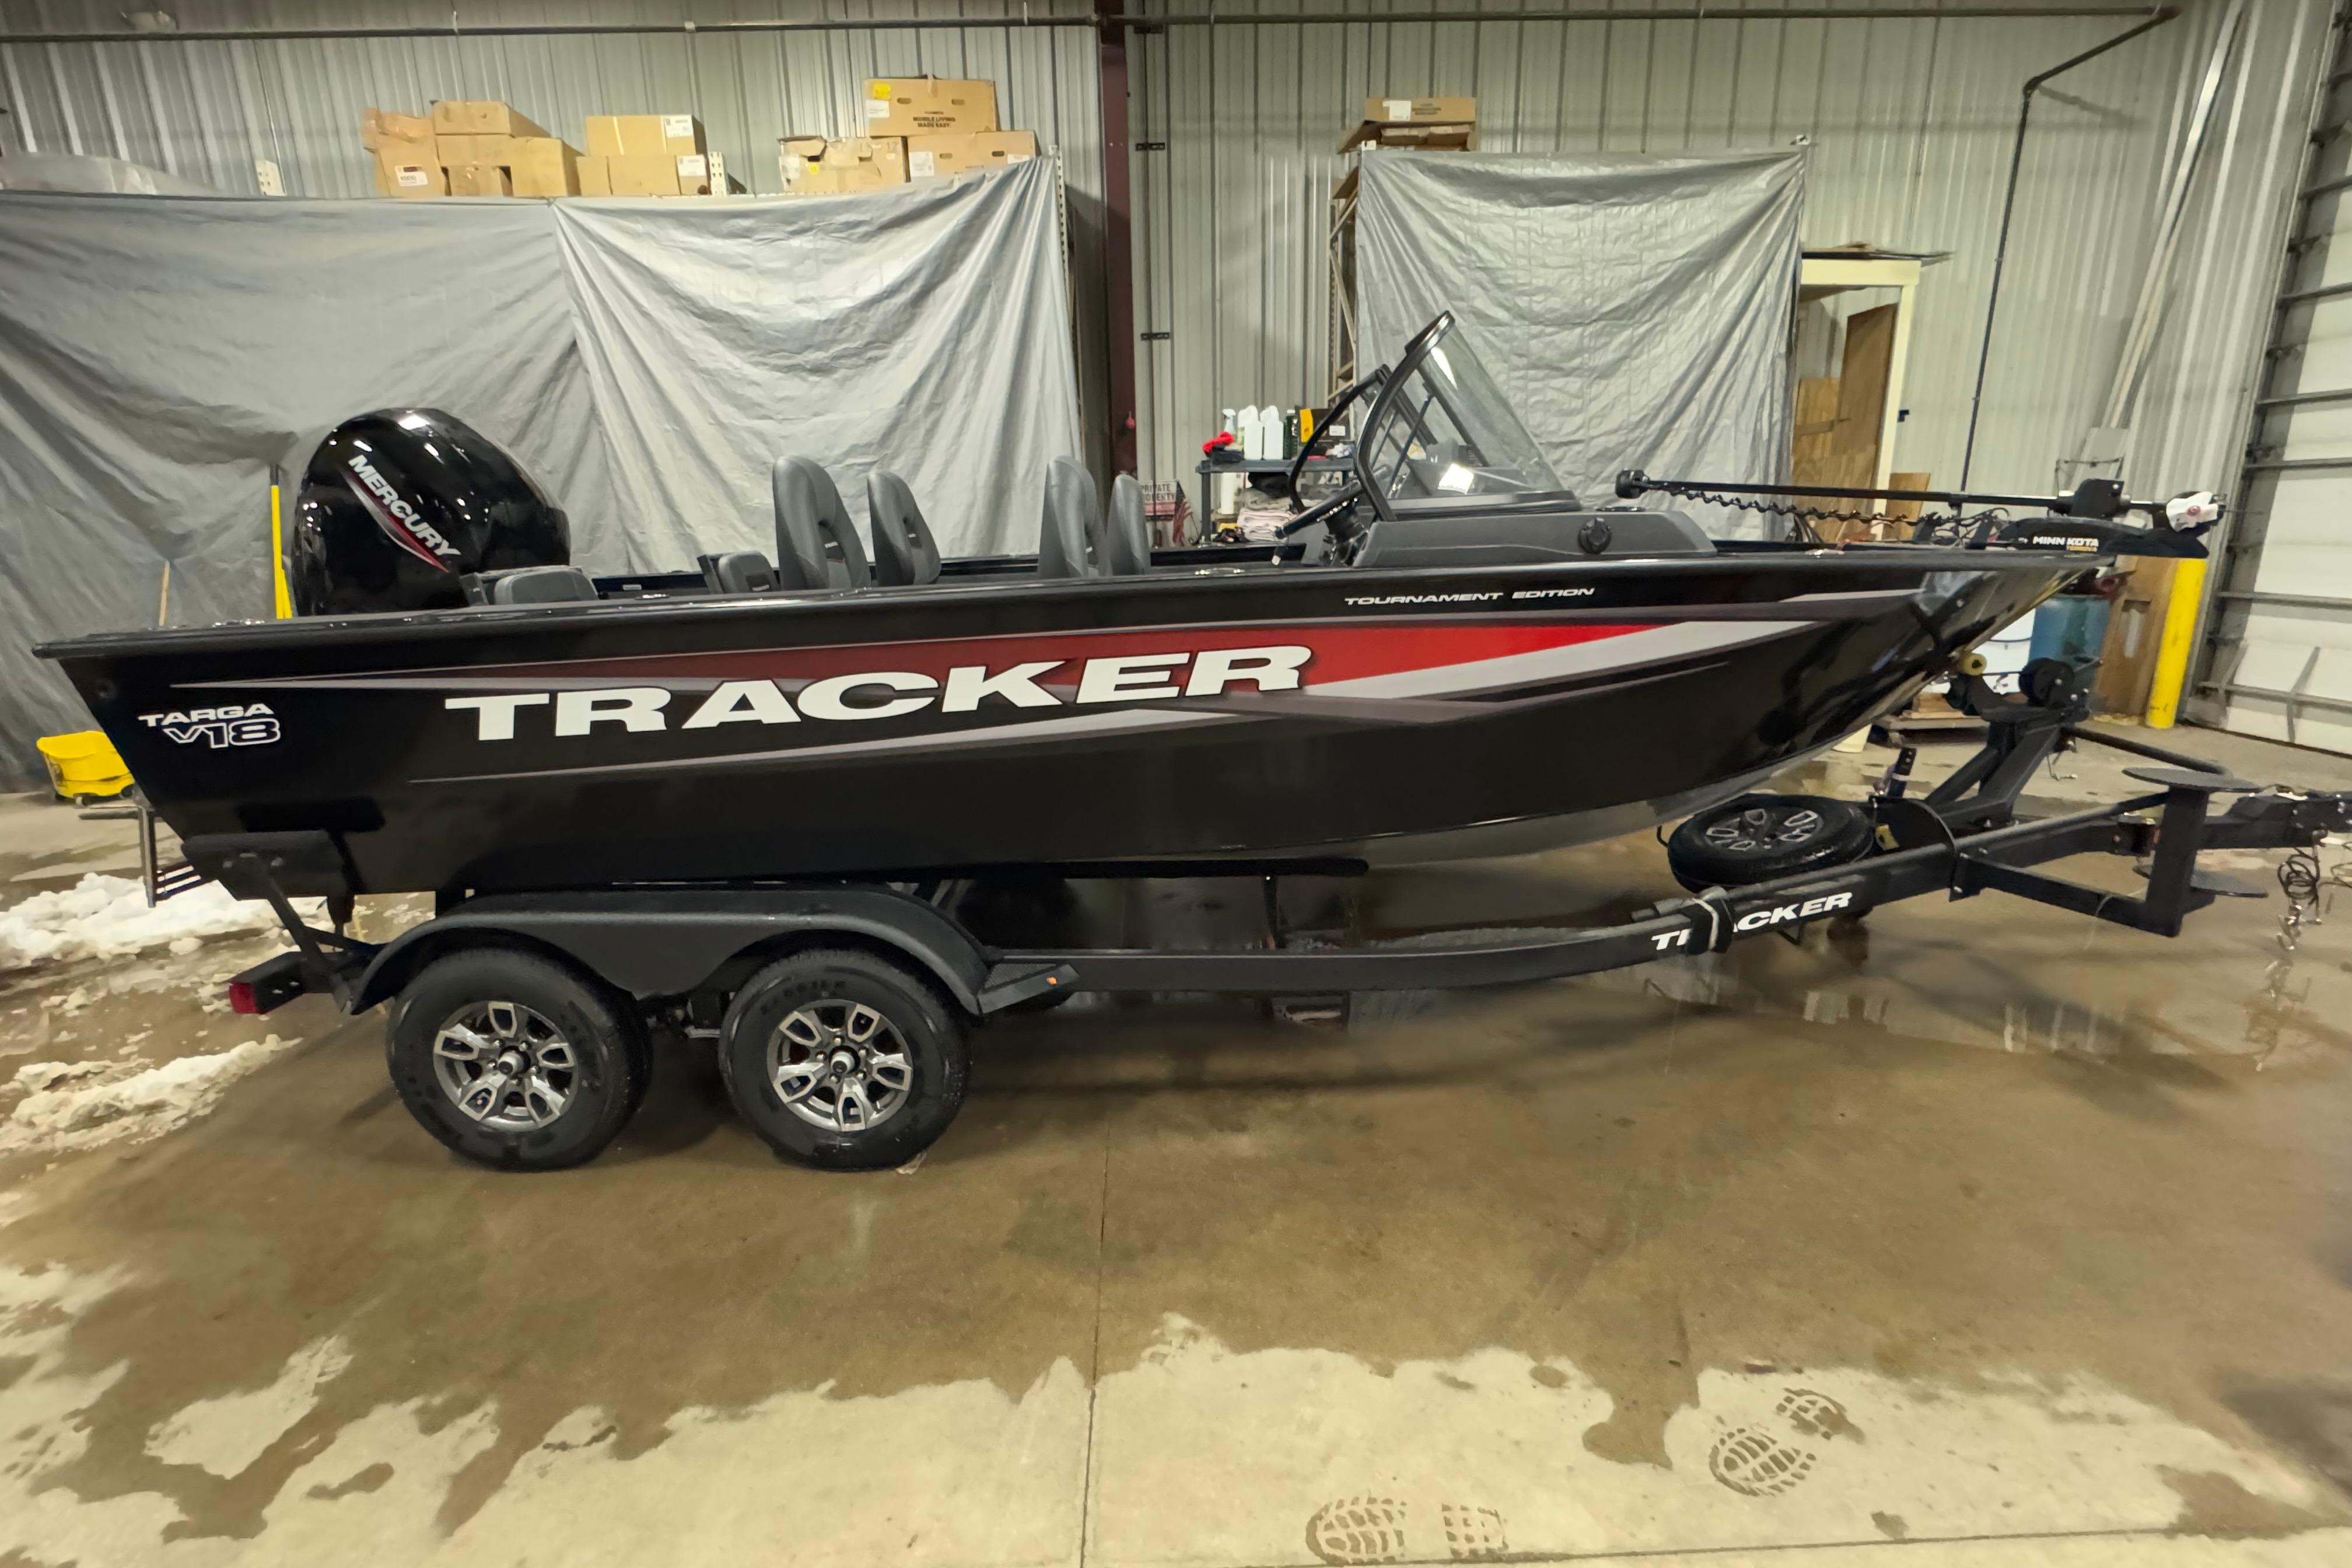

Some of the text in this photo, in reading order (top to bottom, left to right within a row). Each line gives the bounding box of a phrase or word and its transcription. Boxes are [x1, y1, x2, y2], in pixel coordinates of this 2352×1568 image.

[348, 454, 461, 555] MERCURY
[2033, 536, 2099, 547] MINN KOTA
[1345, 587, 1595, 606] TOURNAMENT EDITION
[445, 646, 1312, 741] TRACKER
[138, 702, 275, 727] TARGA
[162, 718, 281, 749] V18
[1651, 892, 1853, 951] TCKER
